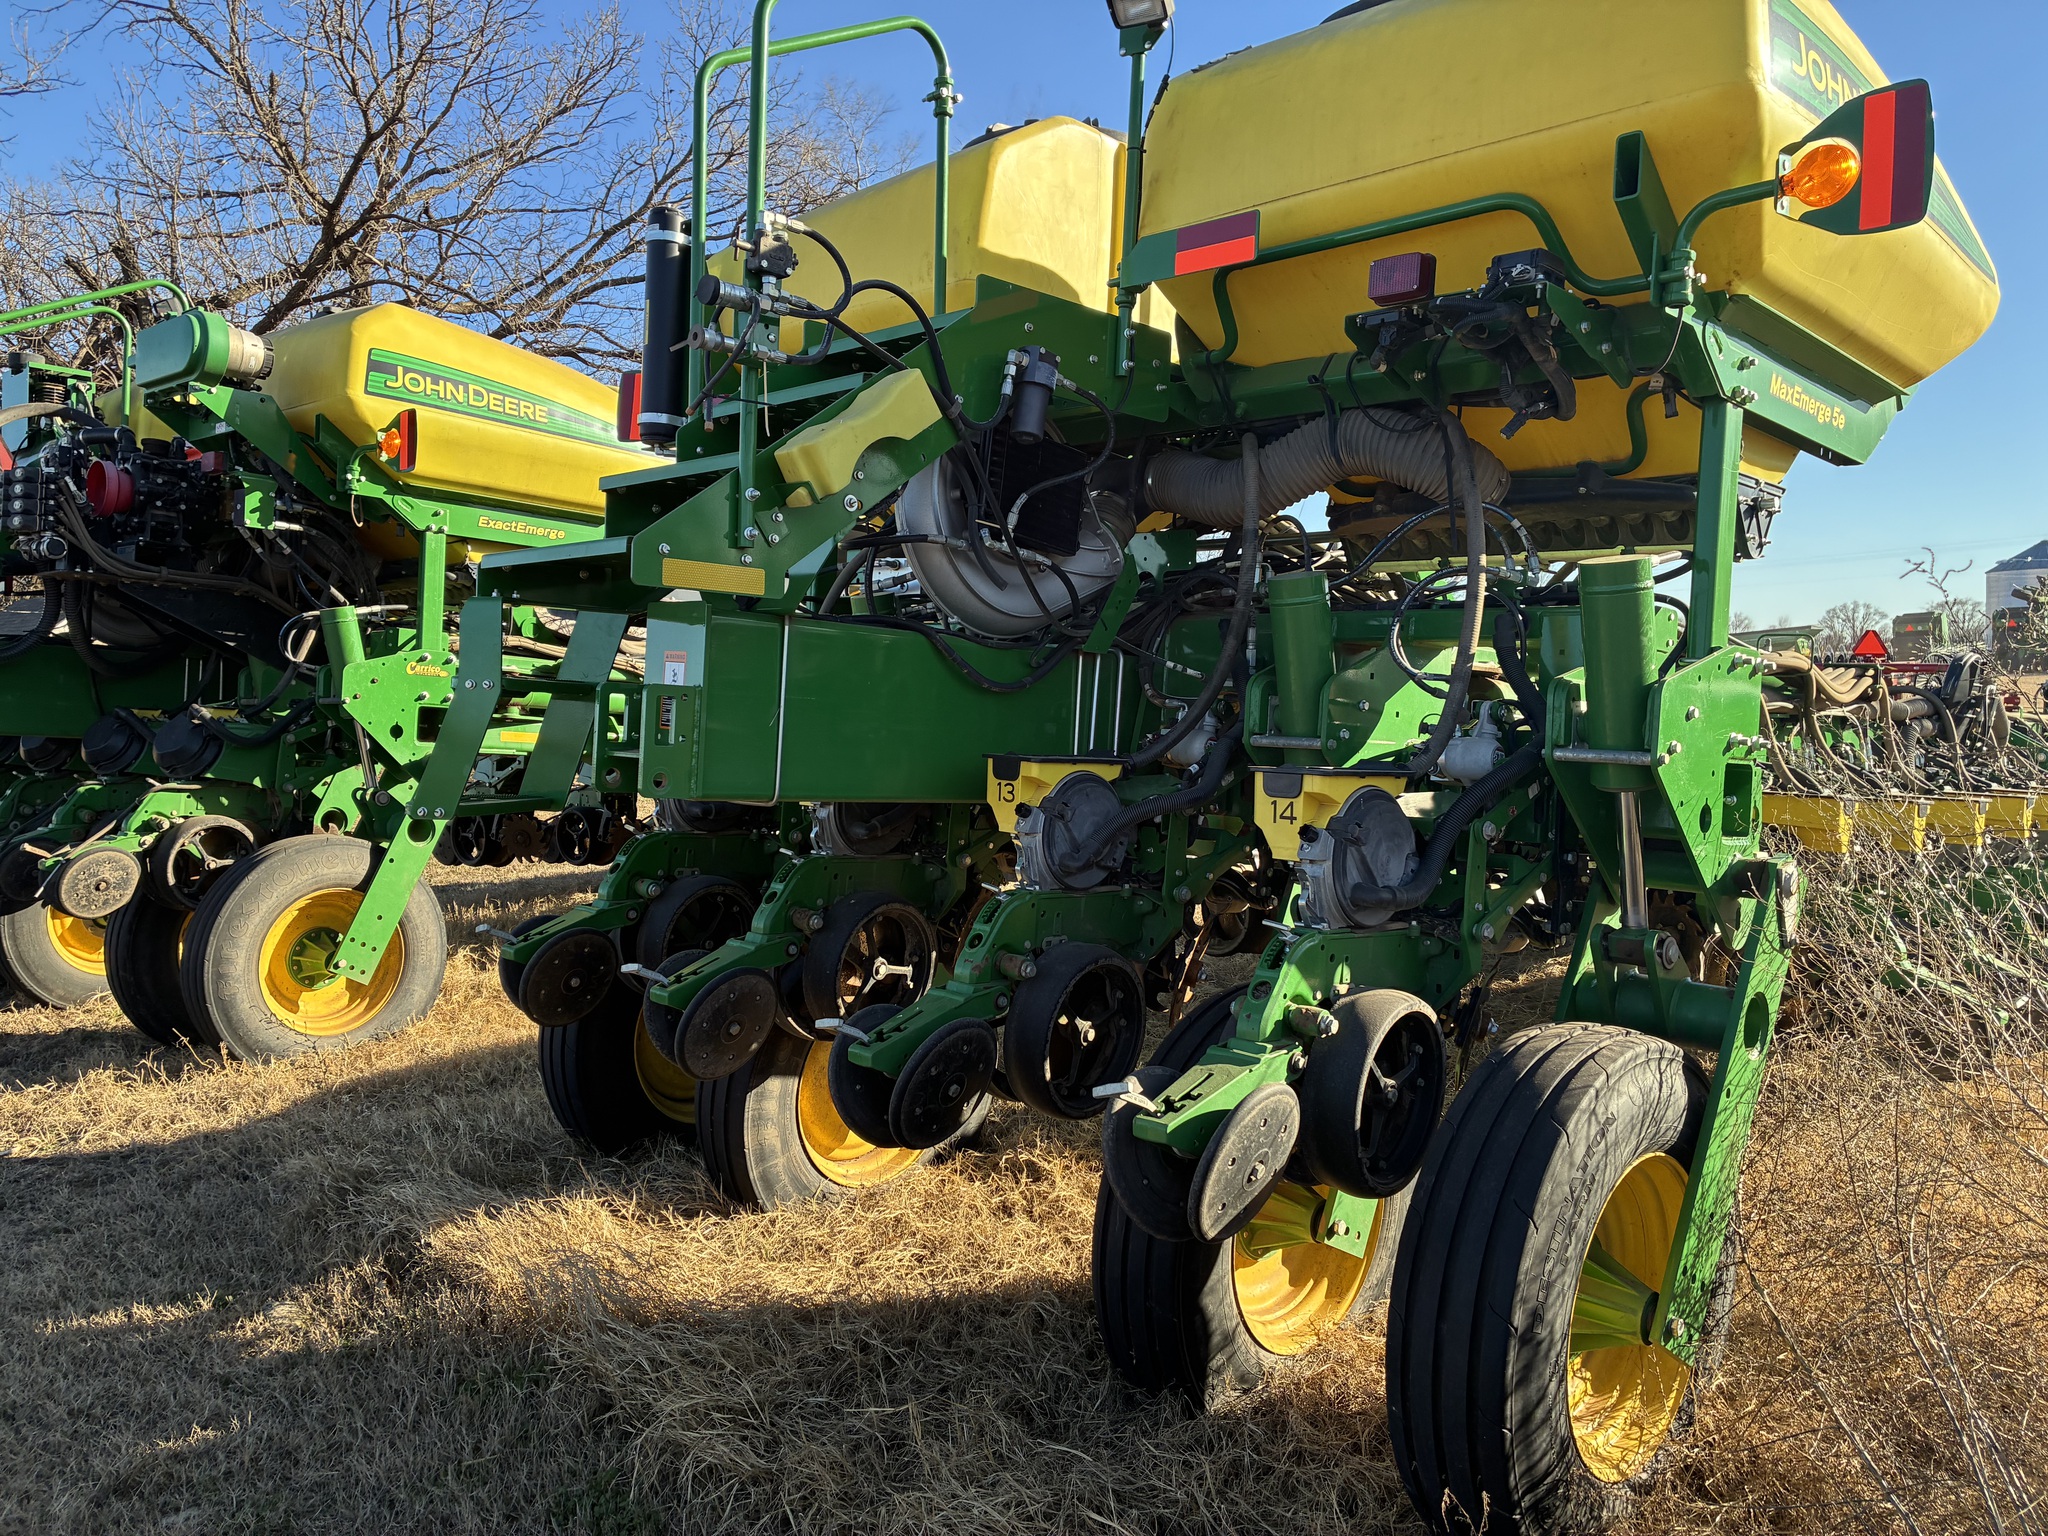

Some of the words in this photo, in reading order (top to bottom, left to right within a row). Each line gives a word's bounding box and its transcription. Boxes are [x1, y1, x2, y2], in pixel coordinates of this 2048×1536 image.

[385, 366, 464, 404] JOHN
[468, 384, 549, 424] DEERE
[1770, 372, 1832, 424] MaxEmerge
[1832, 406, 1846, 430] 5e
[478, 515, 566, 540] ExactEmerge
[997, 781, 1015, 803] 13
[1270, 799, 1298, 826] 14
[1531, 1110, 1617, 1336] DESTINATION
